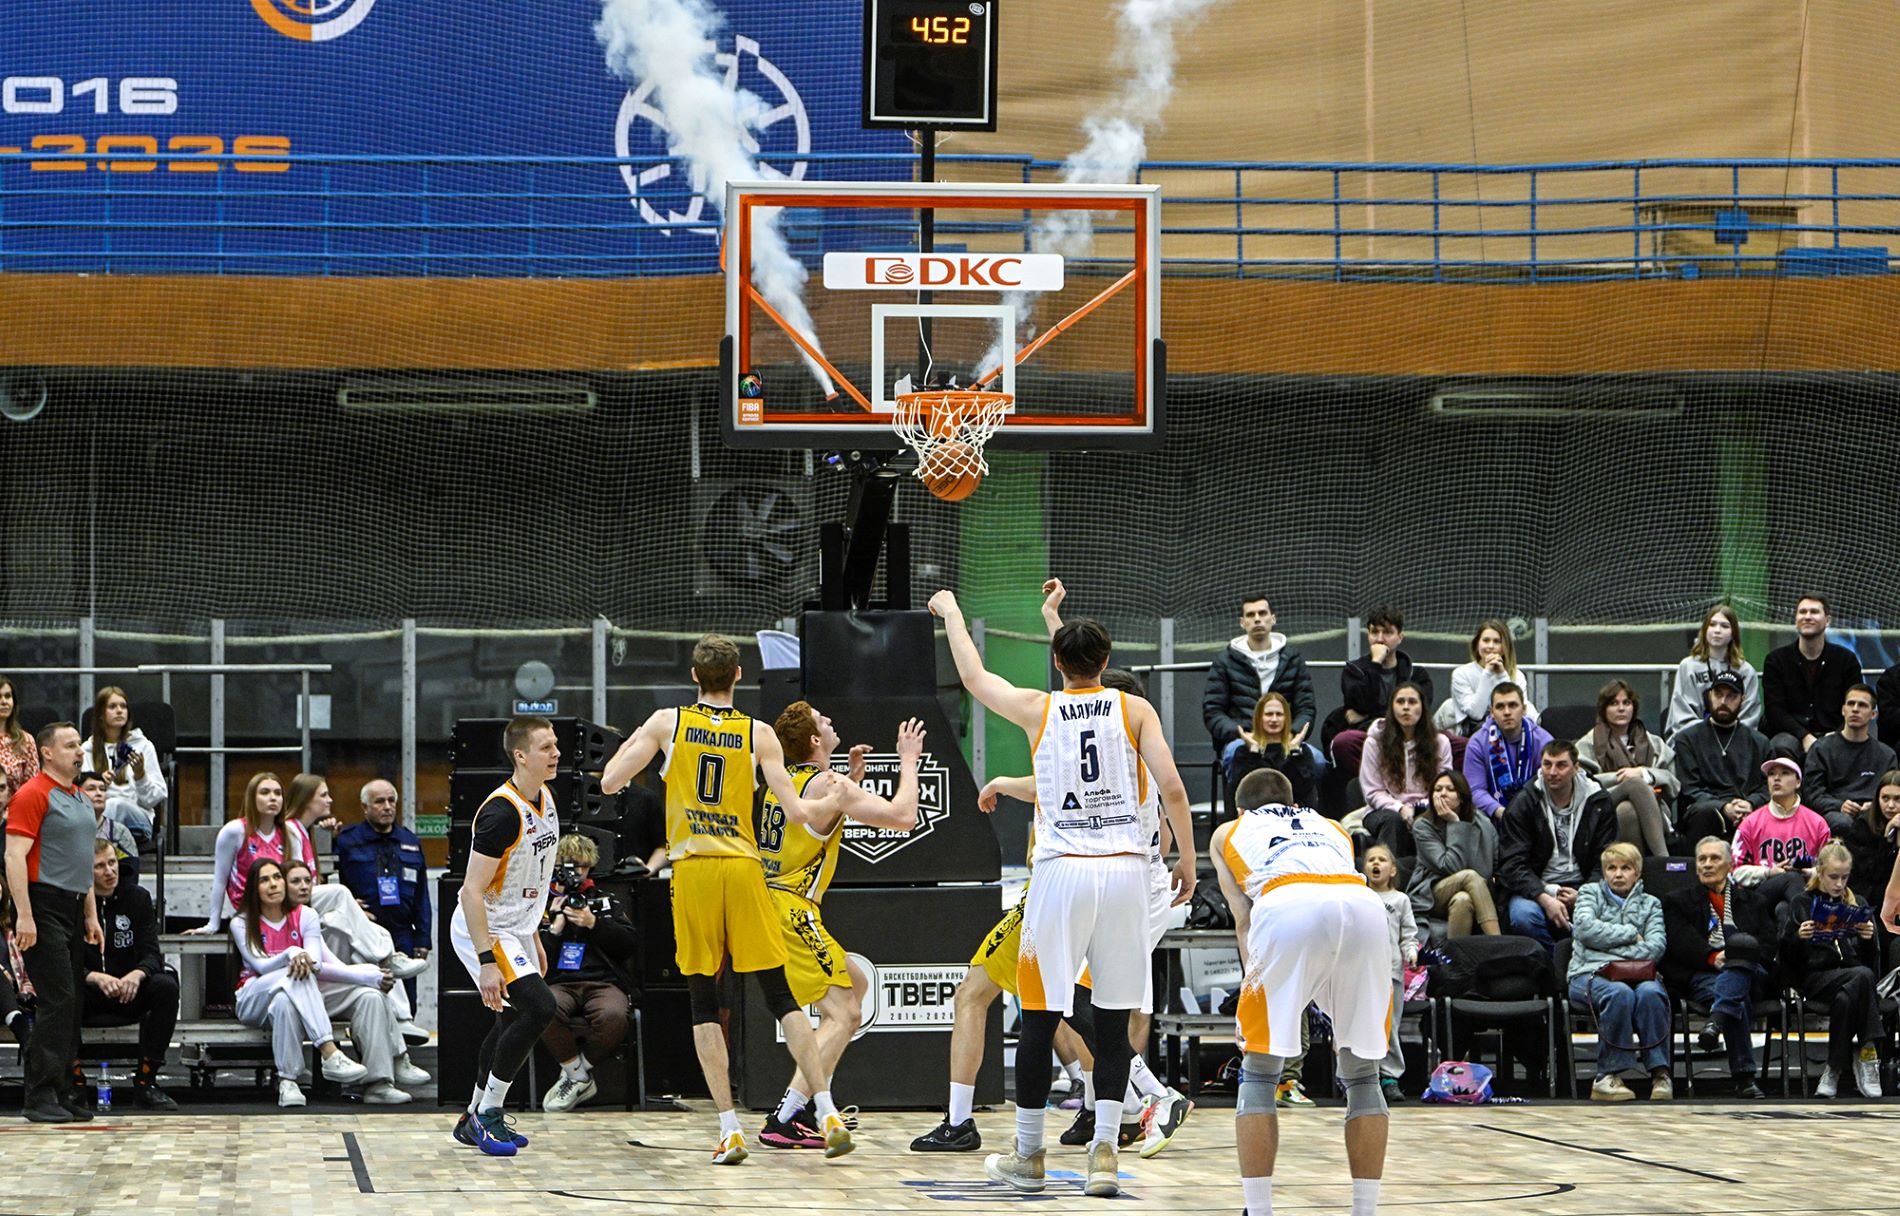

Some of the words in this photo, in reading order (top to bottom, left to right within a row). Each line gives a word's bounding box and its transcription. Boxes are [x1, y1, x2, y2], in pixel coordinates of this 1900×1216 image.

[911, 17, 970, 44] 4.52
[919, 257, 1022, 286] DKC
[742, 402, 760, 412] FIBA
[685, 727, 743, 749] ПИКАЛОВ
[1080, 729, 1100, 783] 5
[832, 764, 889, 773] ЧЕМОНАТ
[697, 752, 725, 805] 0
[1084, 788, 1111, 798] Альфа
[416, 823, 449, 834] ЫХОД
[842, 828, 876, 838] ВЕРЬ
[884, 972, 943, 981] БАСКЕТБОЛЬНЫЙ
[946, 972, 964, 980] КЛУБ
[882, 982, 961, 1007] ТВЕР
